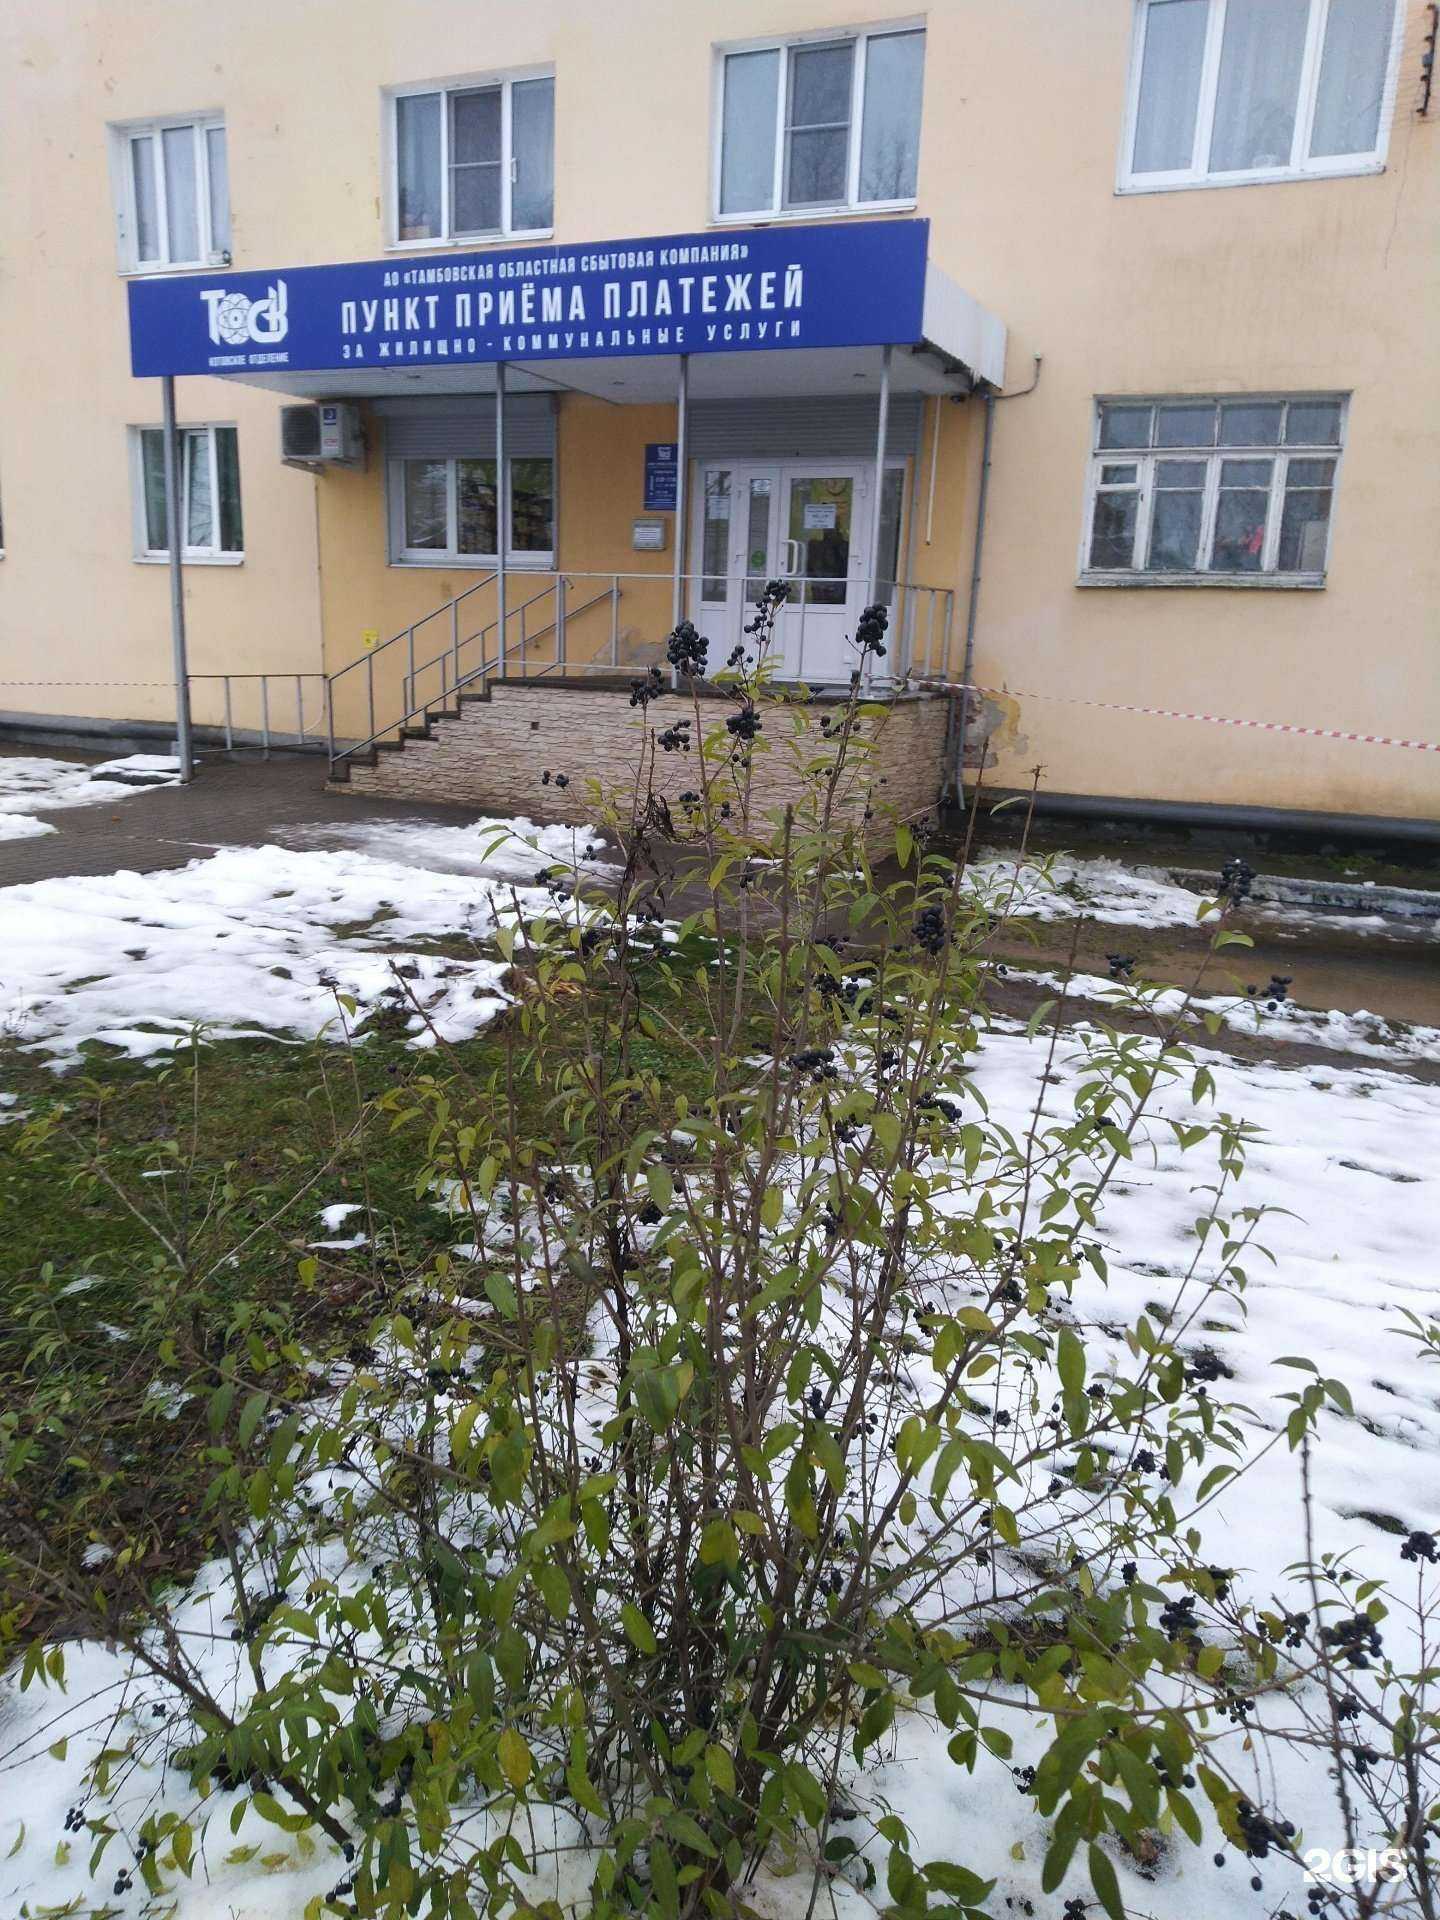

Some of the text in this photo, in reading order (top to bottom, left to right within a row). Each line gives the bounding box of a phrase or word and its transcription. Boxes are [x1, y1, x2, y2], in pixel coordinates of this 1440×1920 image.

[383, 243, 748, 287] АО «ТАМБОВСКАЯ ОБЛАСТНАЯ СБЫТОВАЯ КОМПАНИЯ»
[341, 264, 803, 334] ПУНКТ ПРИЁМА ПЛАТЕЖЕЙ
[342, 343, 364, 360] ЗА
[379, 337, 476, 357] ЖИЛИЩНО
[503, 326, 684, 351] КОММУНАЛЬНЫЕ
[707, 320, 801, 341] УСЛУГИ
